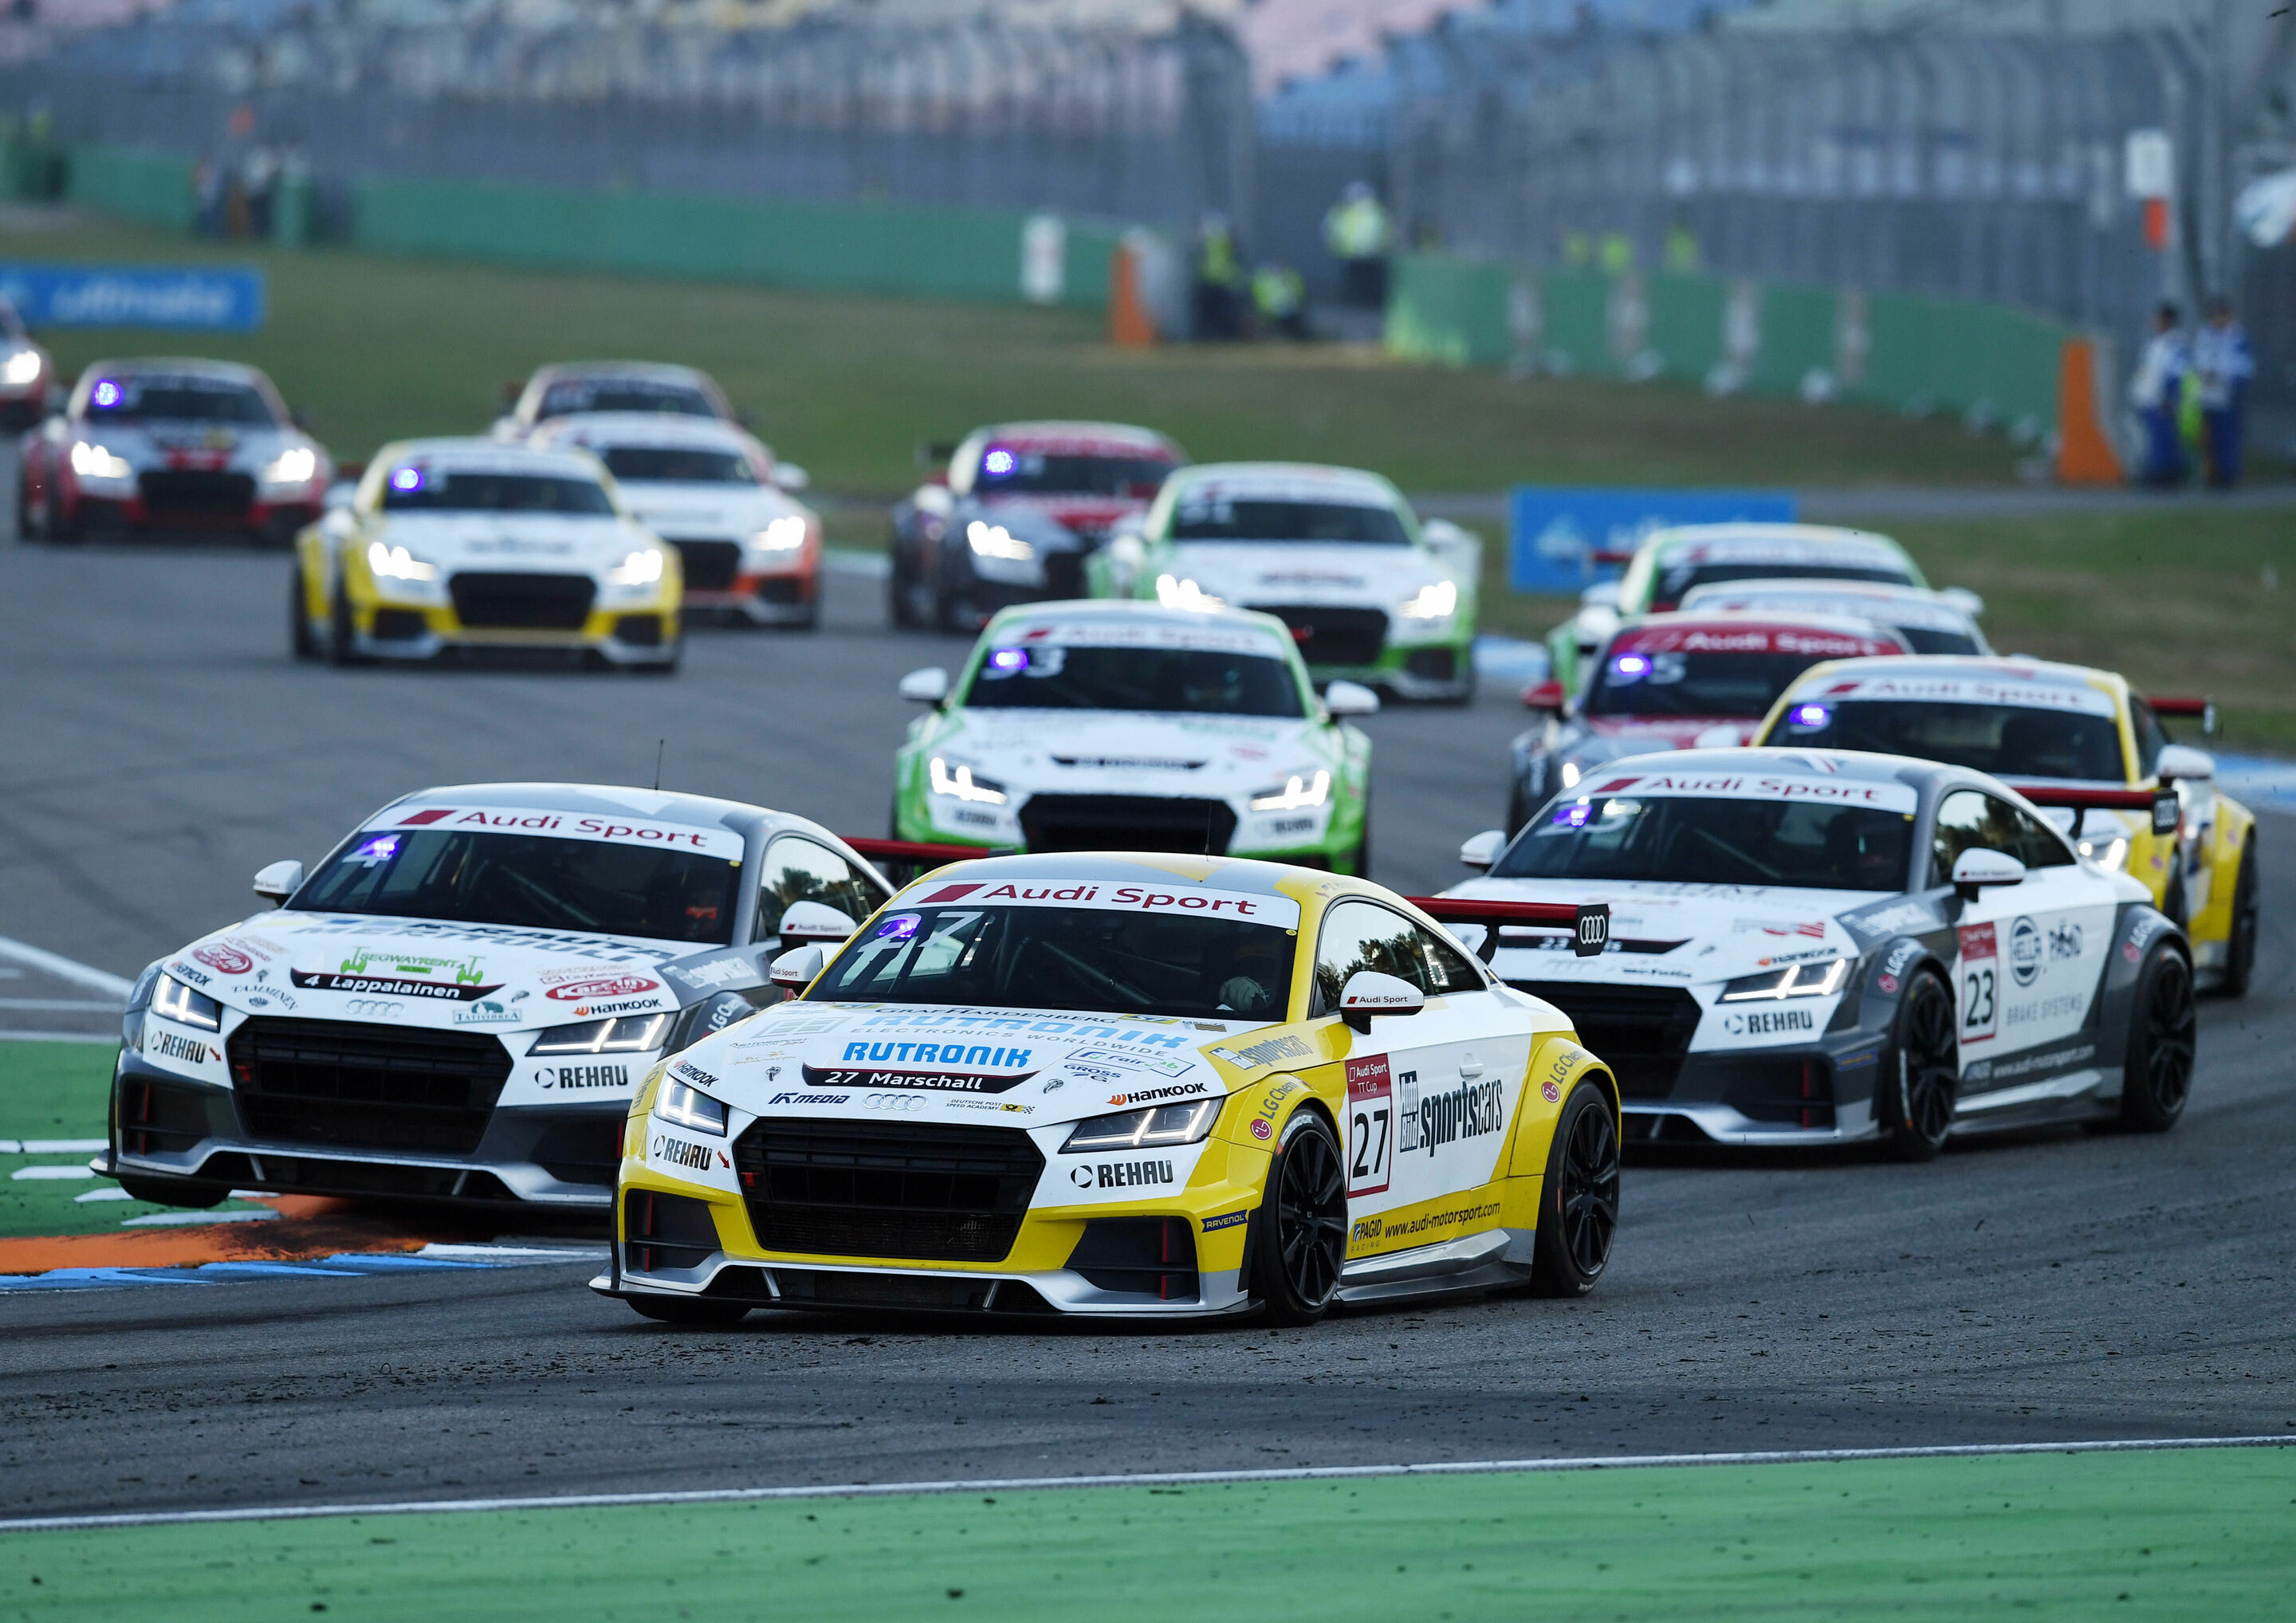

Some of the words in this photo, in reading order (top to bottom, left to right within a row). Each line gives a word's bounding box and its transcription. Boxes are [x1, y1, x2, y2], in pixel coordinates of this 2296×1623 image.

[1682, 631, 1769, 651] Audi
[1775, 633, 1879, 656] Sport
[1877, 676, 1960, 694] Audi
[1976, 683, 2082, 703] Sport
[1645, 776, 1745, 792] Audi
[1755, 777, 1881, 802] Sport
[455, 811, 564, 830] Audi
[574, 818, 710, 848] Sport
[981, 883, 1100, 902] Audi
[1111, 886, 1257, 916] Sport
[1537, 936, 1571, 950] 23
[305, 974, 320, 987] 4
[329, 975, 461, 999] Lappalainen
[782, 969, 798, 978] Sport
[1383, 996, 1408, 1004] Sport
[1966, 969, 1994, 1028] 23
[861, 1016, 1189, 1049] RUTRONIK
[1748, 1009, 1814, 1035] REHAU
[161, 1035, 207, 1064] REHAU
[842, 1041, 1032, 1068] RUTRONIK
[850, 1027, 1016, 1038] ELECTRONICS
[1027, 1035, 1169, 1057] WORLDWIDE
[559, 1064, 628, 1089] REHAU
[824, 1071, 859, 1084] 27
[867, 1072, 983, 1090] Marschall
[1063, 1064, 1122, 1079] GROSS
[1356, 1065, 1370, 1078] Audi
[1370, 1063, 1388, 1076] Sport
[1549, 1063, 1568, 1084] LG
[1258, 1098, 1280, 1120] LG
[1270, 1080, 1301, 1102] Chem
[1357, 1082, 1366, 1094] TT
[1366, 1081, 1378, 1094] Cup
[663, 1138, 713, 1171] REHAU
[1352, 1108, 1389, 1179] 27
[1097, 1159, 1174, 1189] REHAU
[1205, 1214, 1244, 1228] RAVENOL
[1359, 1218, 1382, 1241] PAGID
[1384, 1201, 1500, 1239] www.audi-motorsport.com
[1350, 1240, 1381, 1253] RACING
